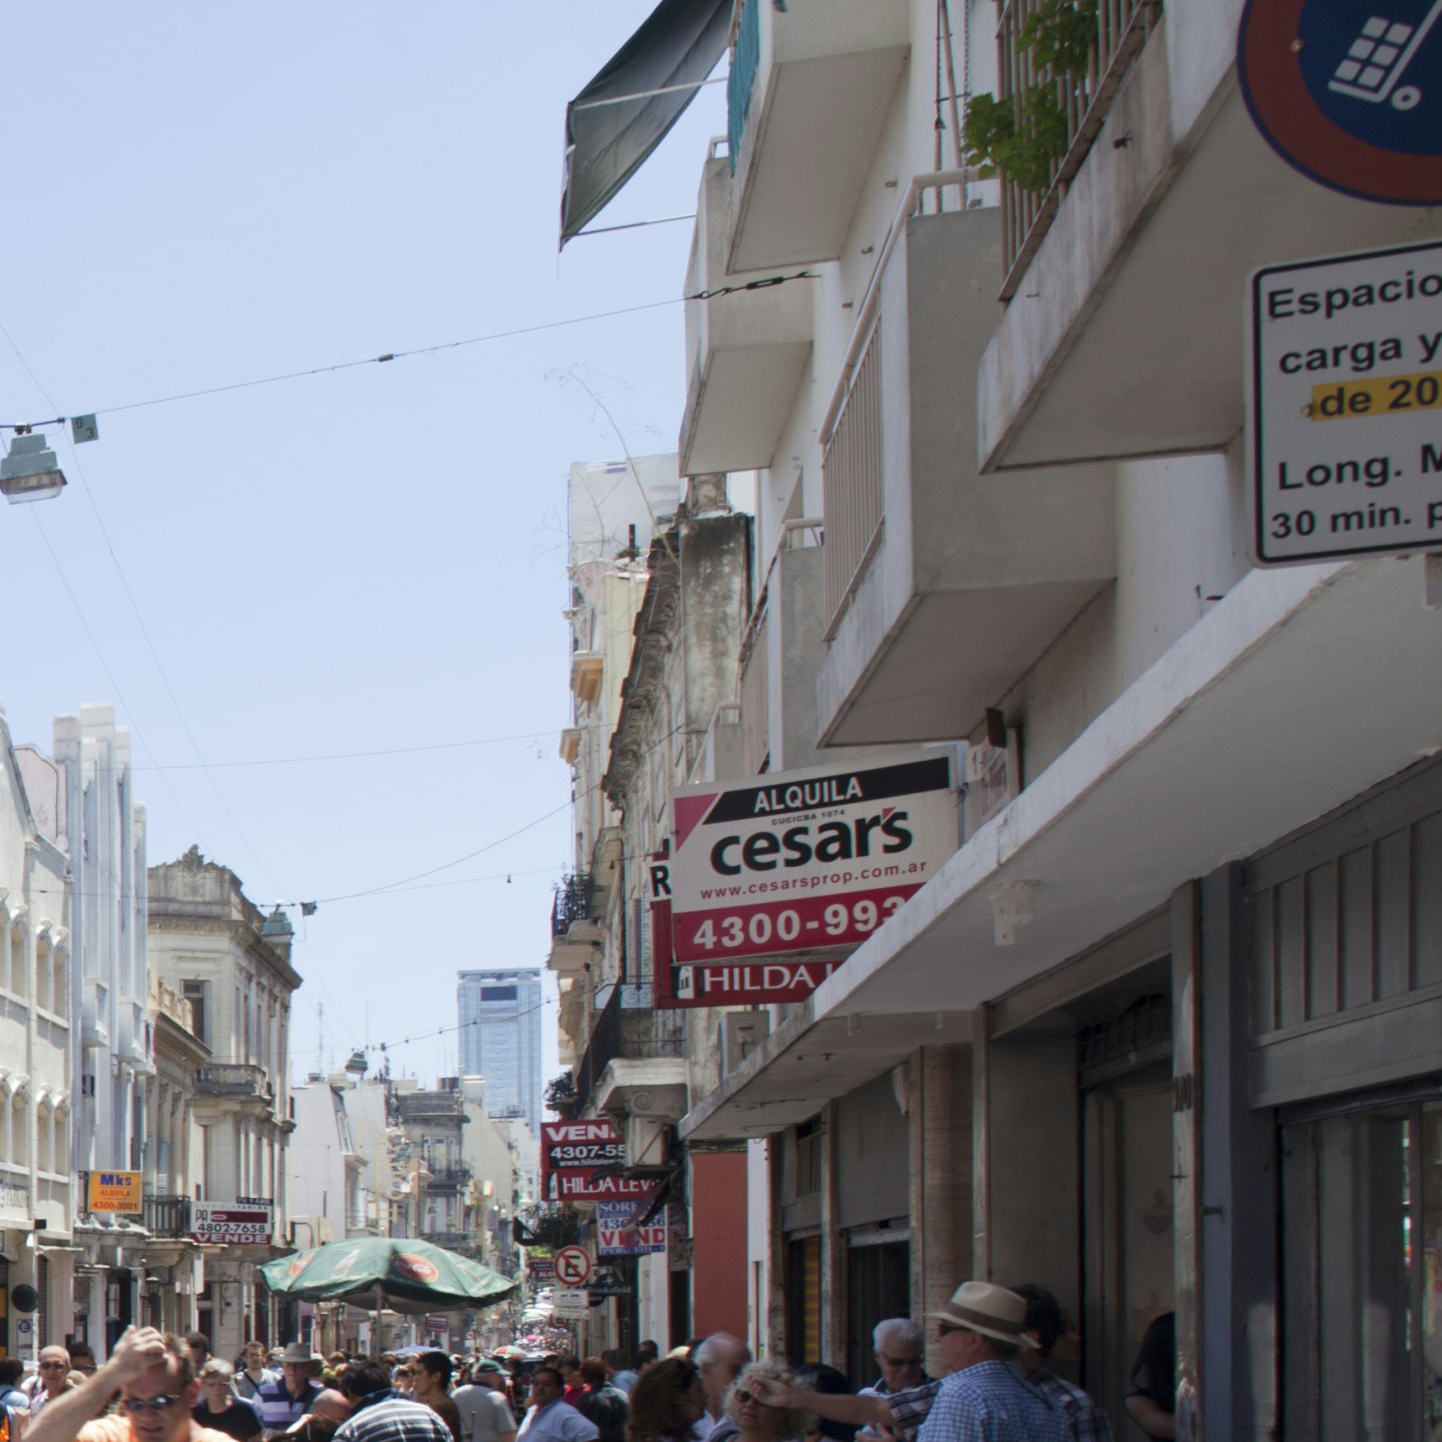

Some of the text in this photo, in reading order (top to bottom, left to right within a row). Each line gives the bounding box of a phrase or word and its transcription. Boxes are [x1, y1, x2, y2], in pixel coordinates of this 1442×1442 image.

[1267, 270, 1442, 319] Espacio
[1279, 337, 1402, 375] carga
[1319, 376, 1439, 418] de 20
[1277, 456, 1403, 491] Long.
[1271, 509, 1316, 540] 30
[1330, 502, 1412, 533] min.
[753, 776, 863, 813] ALQUILA
[821, 808, 846, 820] 1074
[699, 860, 928, 900] www.cesarsprop.com.ar
[703, 966, 816, 994] HILDA
[545, 1125, 616, 1141] VEN
[100, 1174, 132, 1186] Mks
[562, 1176, 660, 1193] HILDA LEV
[93, 1201, 138, 1210] 4300-3001
[196, 1234, 268, 1243] VENDE
[198, 1224, 265, 1232] 4802-7658
